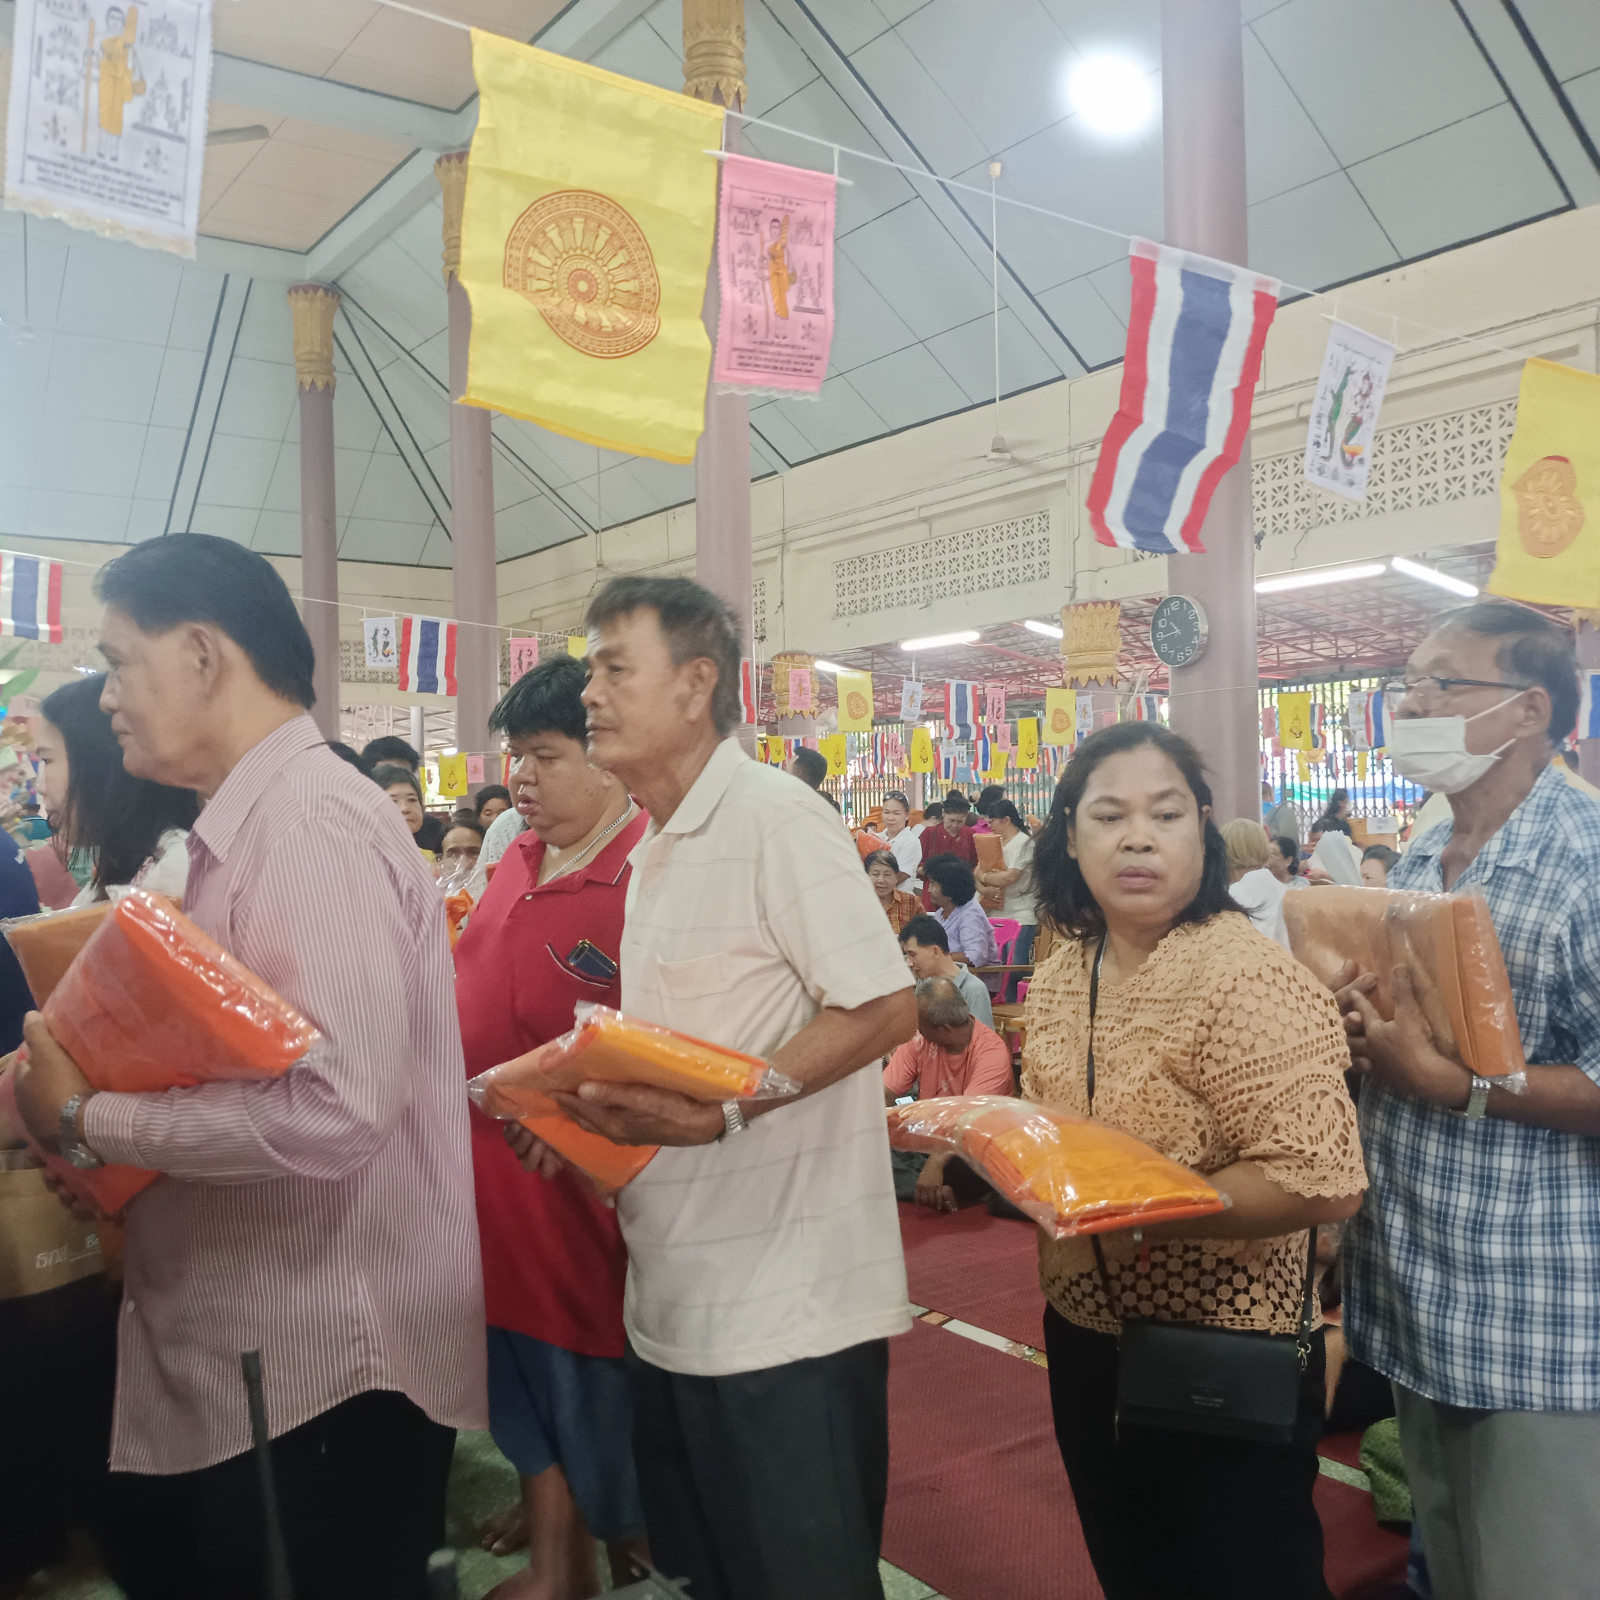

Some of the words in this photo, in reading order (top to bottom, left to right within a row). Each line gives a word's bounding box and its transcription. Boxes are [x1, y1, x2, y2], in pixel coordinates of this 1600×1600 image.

[1170, 600, 1180, 610] 12
[1163, 608, 1170, 616] 11
[1188, 610, 1196, 620] 2
[1158, 619, 1167, 628] 10
[1193, 622, 1199, 631] 3
[1157, 632, 1164, 641] 9
[1191, 636, 1198, 644] 4
[1161, 644, 1168, 652] 8
[1185, 646, 1192, 656] 5
[1168, 650, 1174, 659] 7
[1177, 652, 1184, 661] 6
